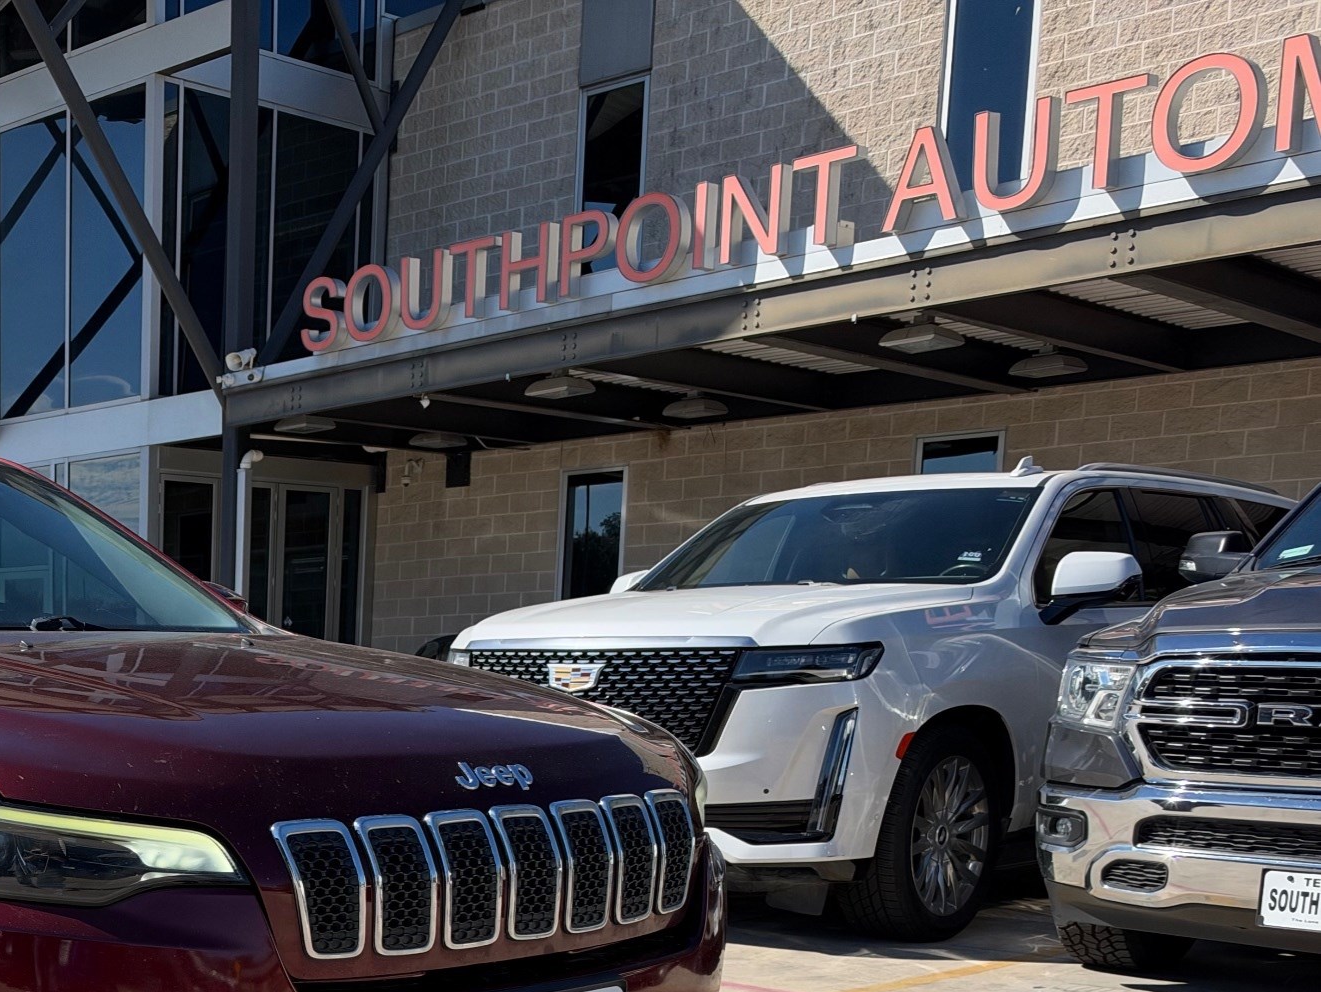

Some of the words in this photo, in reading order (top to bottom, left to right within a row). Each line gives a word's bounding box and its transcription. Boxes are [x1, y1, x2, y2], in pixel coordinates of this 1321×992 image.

[300, 144, 867, 352] SOUTHPOINT
[455, 761, 534, 791] Jeep
[1268, 888, 1320, 915] SOUTH
